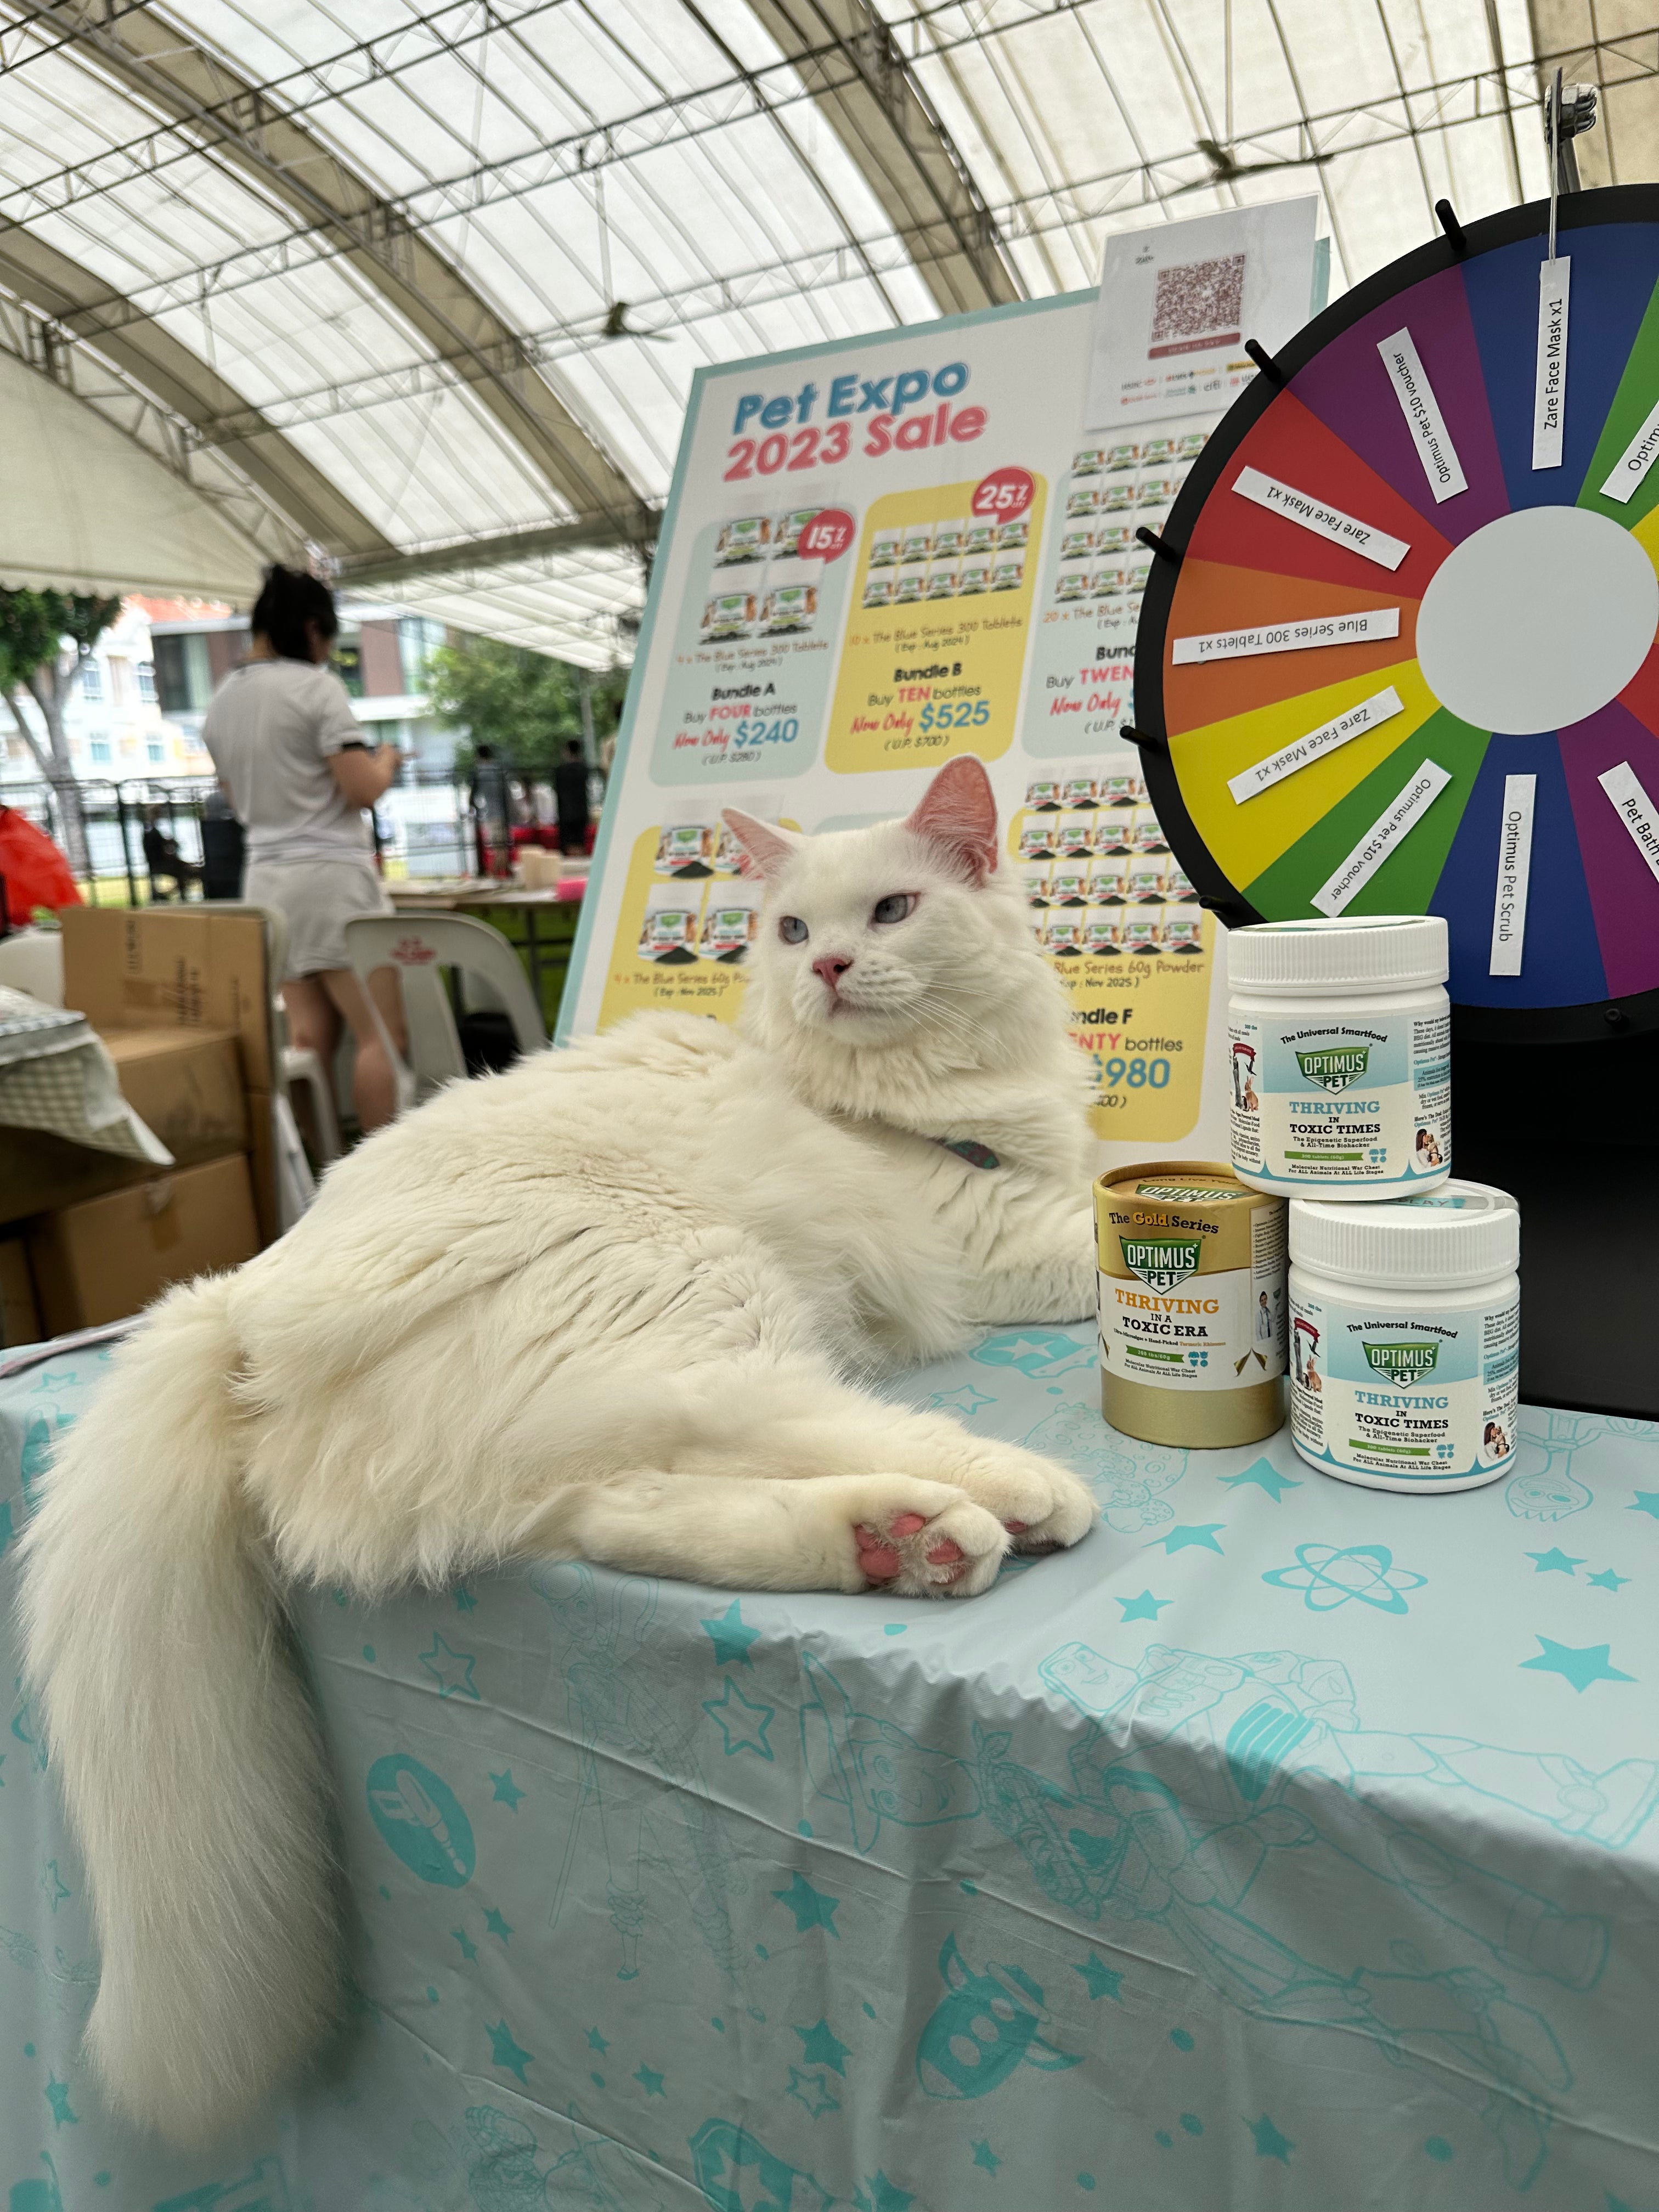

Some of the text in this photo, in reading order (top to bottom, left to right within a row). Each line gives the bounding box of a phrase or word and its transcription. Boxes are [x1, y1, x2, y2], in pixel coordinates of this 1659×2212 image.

[1544, 298, 1562, 430] Zare Face Mask x1
[733, 362, 970, 435] Pet Expo
[1393, 353, 1451, 483] Optimus Pet $10 voucher
[723, 403, 989, 482] 2023 Sale
[1628, 424, 1659, 471] Optim
[1267, 487, 1371, 545] Zare Face Mask x1
[1043, 611, 1059, 623] 20
[1074, 606, 1093, 619] The
[1097, 603, 1124, 617] Blue
[1199, 619, 1367, 653] Blue Series 300 Tablets x1
[894, 662, 962, 682] Bundle B
[1046, 675, 1075, 689] Buy
[712, 682, 776, 701] Bundle A
[867, 685, 982, 707] Buy TEN bottles
[684, 704, 798, 724] Buy FOUR bottles
[1049, 696, 1083, 716] Now
[1086, 691, 1121, 718] Only
[850, 700, 990, 737] Now Only $525
[702, 727, 730, 753] Only
[734, 718, 799, 748] $240
[1255, 709, 1370, 781] Zare Face Mask x1
[1622, 798, 1659, 856] Pet Bath
[1331, 779, 1431, 900] Optimus Pet $10 voucher
[1499, 811, 1522, 941] Optimus Pet Scrub
[1085, 962, 1123, 974] Series
[1128, 961, 1152, 979] 60g
[1156, 959, 1205, 974] Powder
[1086, 979, 1103, 988] Nov
[1122, 1008, 1133, 1024] F
[1125, 1037, 1183, 1052] bottles
[1280, 1027, 1388, 1045] The Universal Smartfood
[1304, 1053, 1364, 1075] OPTIMUS
[1323, 1074, 1350, 1088] PET
[1289, 1101, 1380, 1114] THRIVING
[1290, 1124, 1380, 1134] TOXIC TIMES
[1140, 1187, 1233, 1200] OPTIMUS
[1109, 1211, 1219, 1234] The Gold Series
[1127, 1244, 1195, 1268] OPTIMUS
[1147, 1270, 1176, 1286] PET
[1115, 1288, 1220, 1314] THRIVING
[1122, 1316, 1170, 1335] TOXIC
[1174, 1325, 1208, 1336] ERA
[1151, 1313, 1161, 1322] IN
[1347, 1324, 1363, 1333] The
[1410, 1322, 1458, 1339] Smartfood
[1125, 1358, 1144, 1367] Molecular
[1372, 1348, 1433, 1367] OPTIMUS
[1391, 1369, 1417, 1381] PET
[1355, 1390, 1448, 1409] THRIVING
[1355, 1412, 1448, 1429] TOXIC TIMES
[1372, 1428, 1409, 1437] Epigenetic
[1373, 1434, 1402, 1442] All-Time
[1357, 1453, 1384, 1462] Molecular
